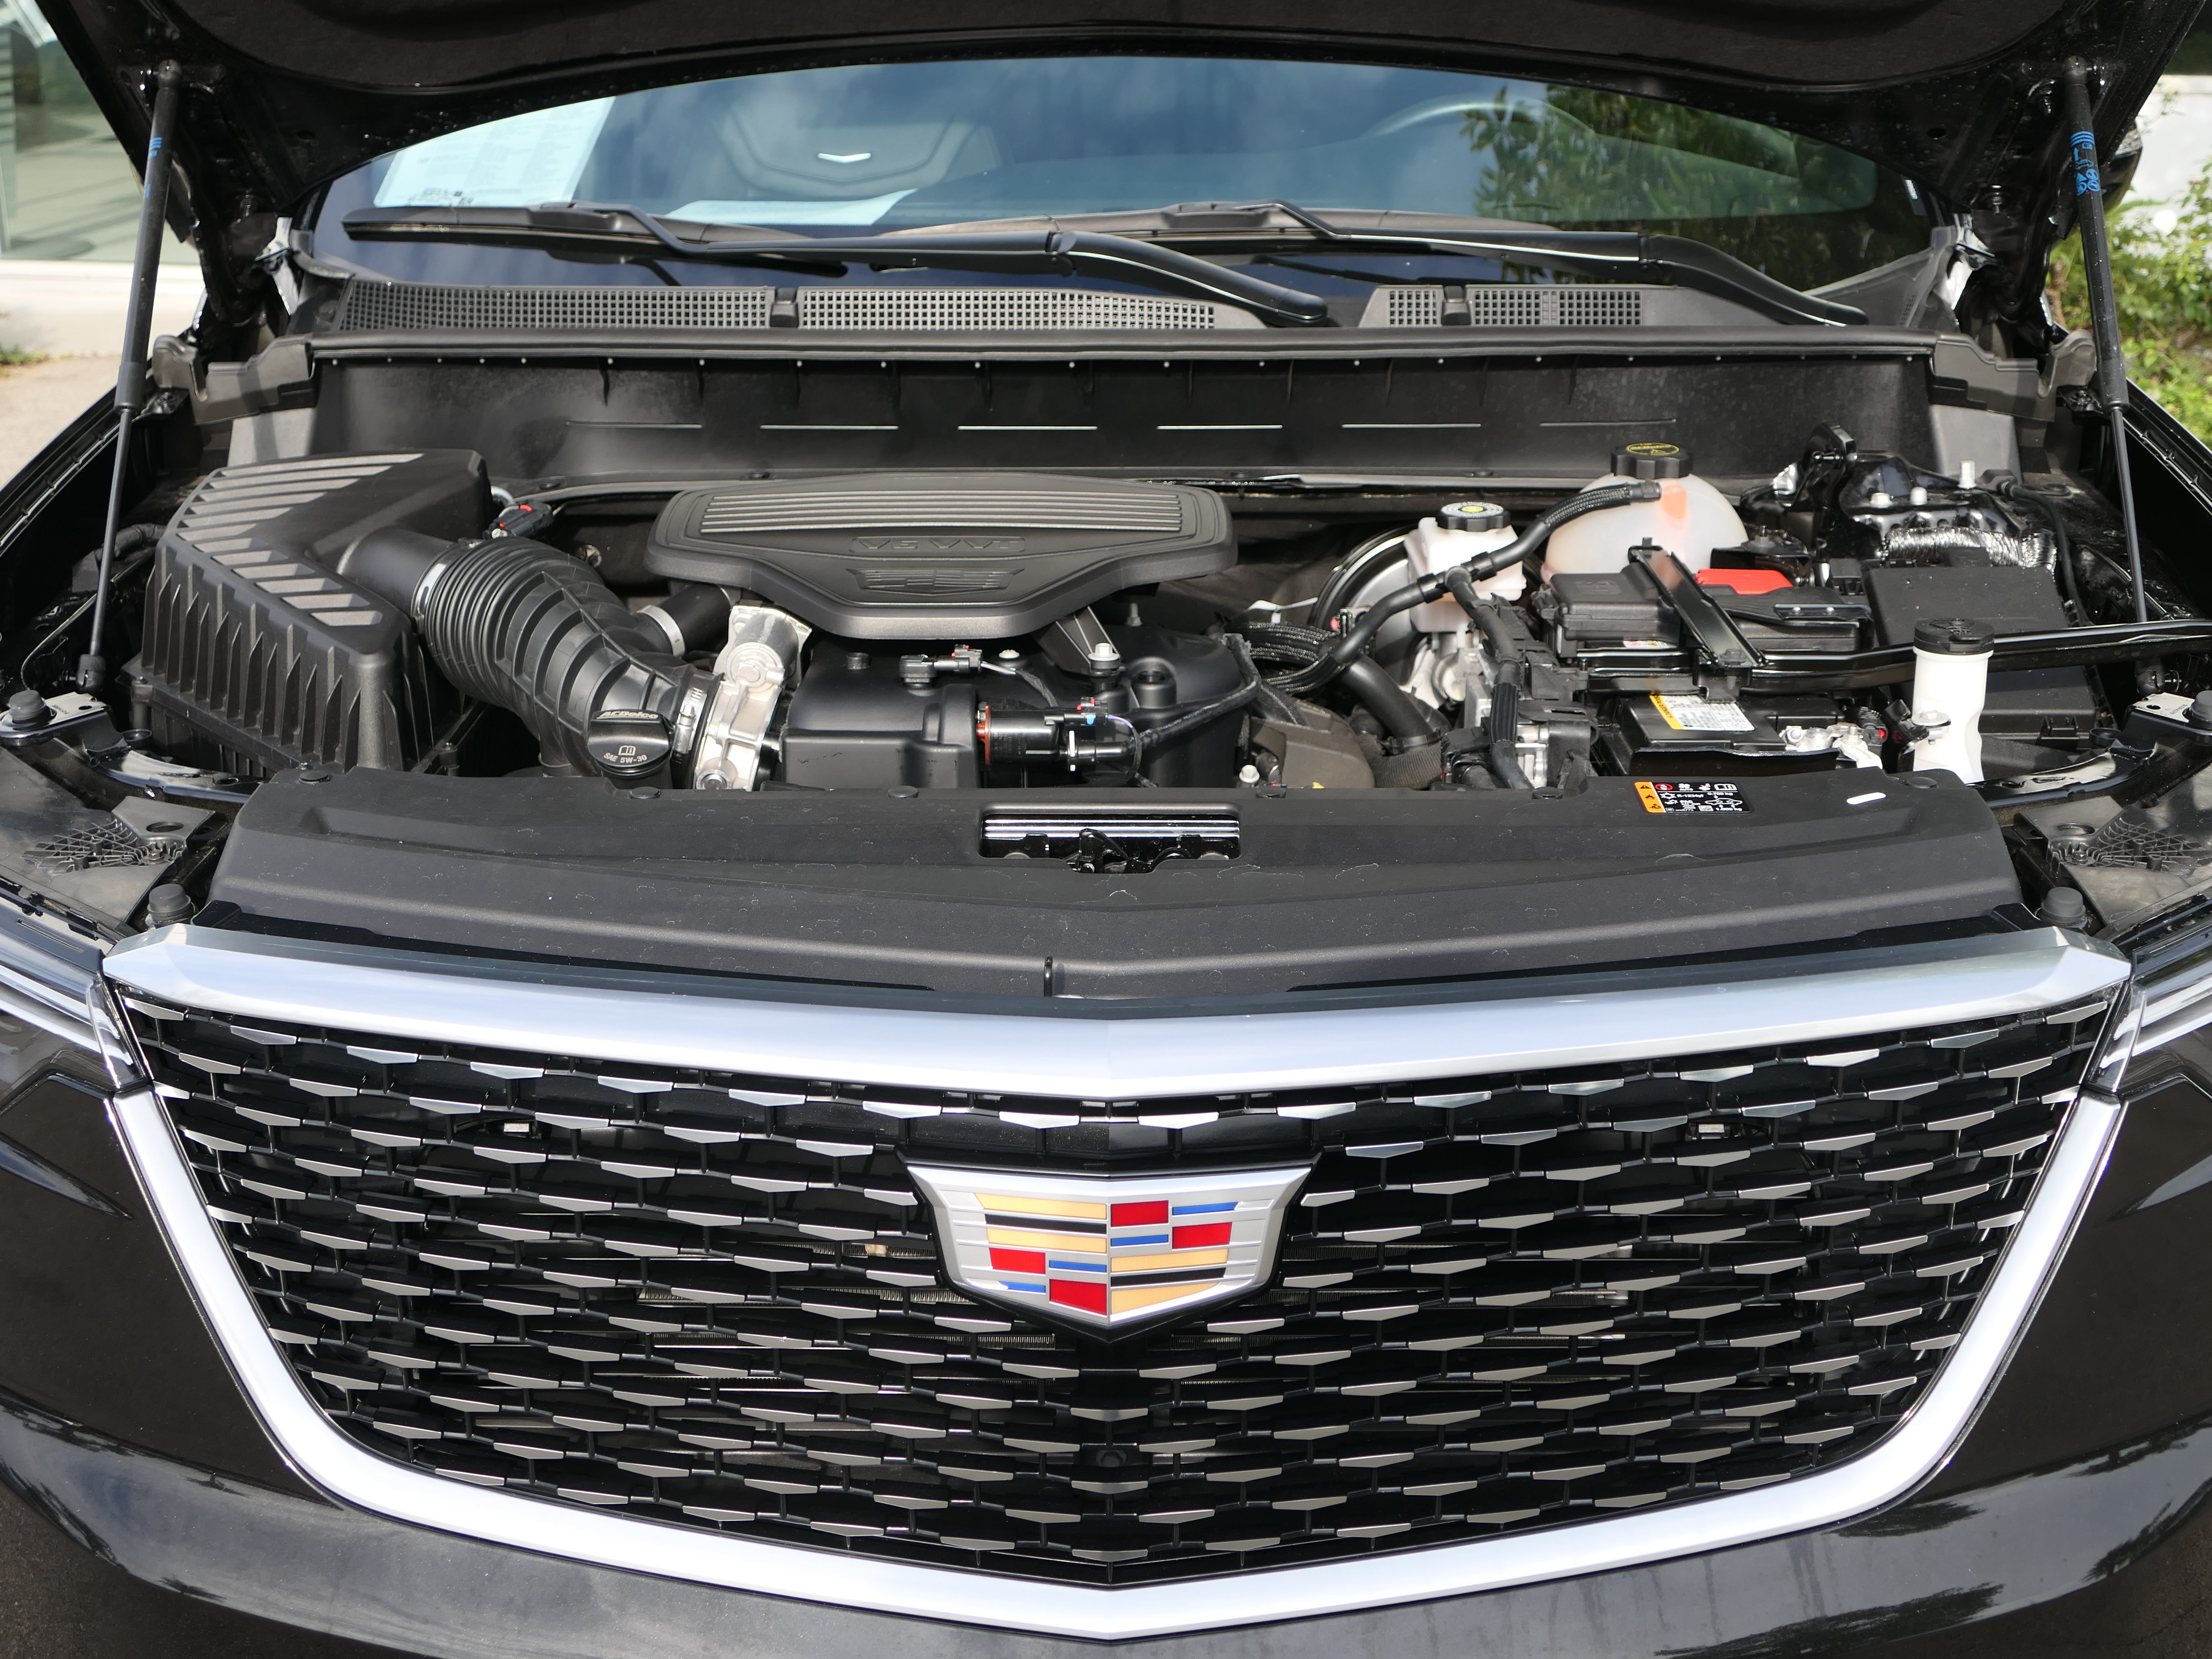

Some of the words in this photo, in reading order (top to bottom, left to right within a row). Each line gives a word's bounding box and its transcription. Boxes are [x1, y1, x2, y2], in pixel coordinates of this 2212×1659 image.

[929, 538, 1020, 549] VVT
[599, 711, 659, 719] ACDelco
[603, 752, 618, 763] SAE
[620, 754, 648, 764] 5W-30
